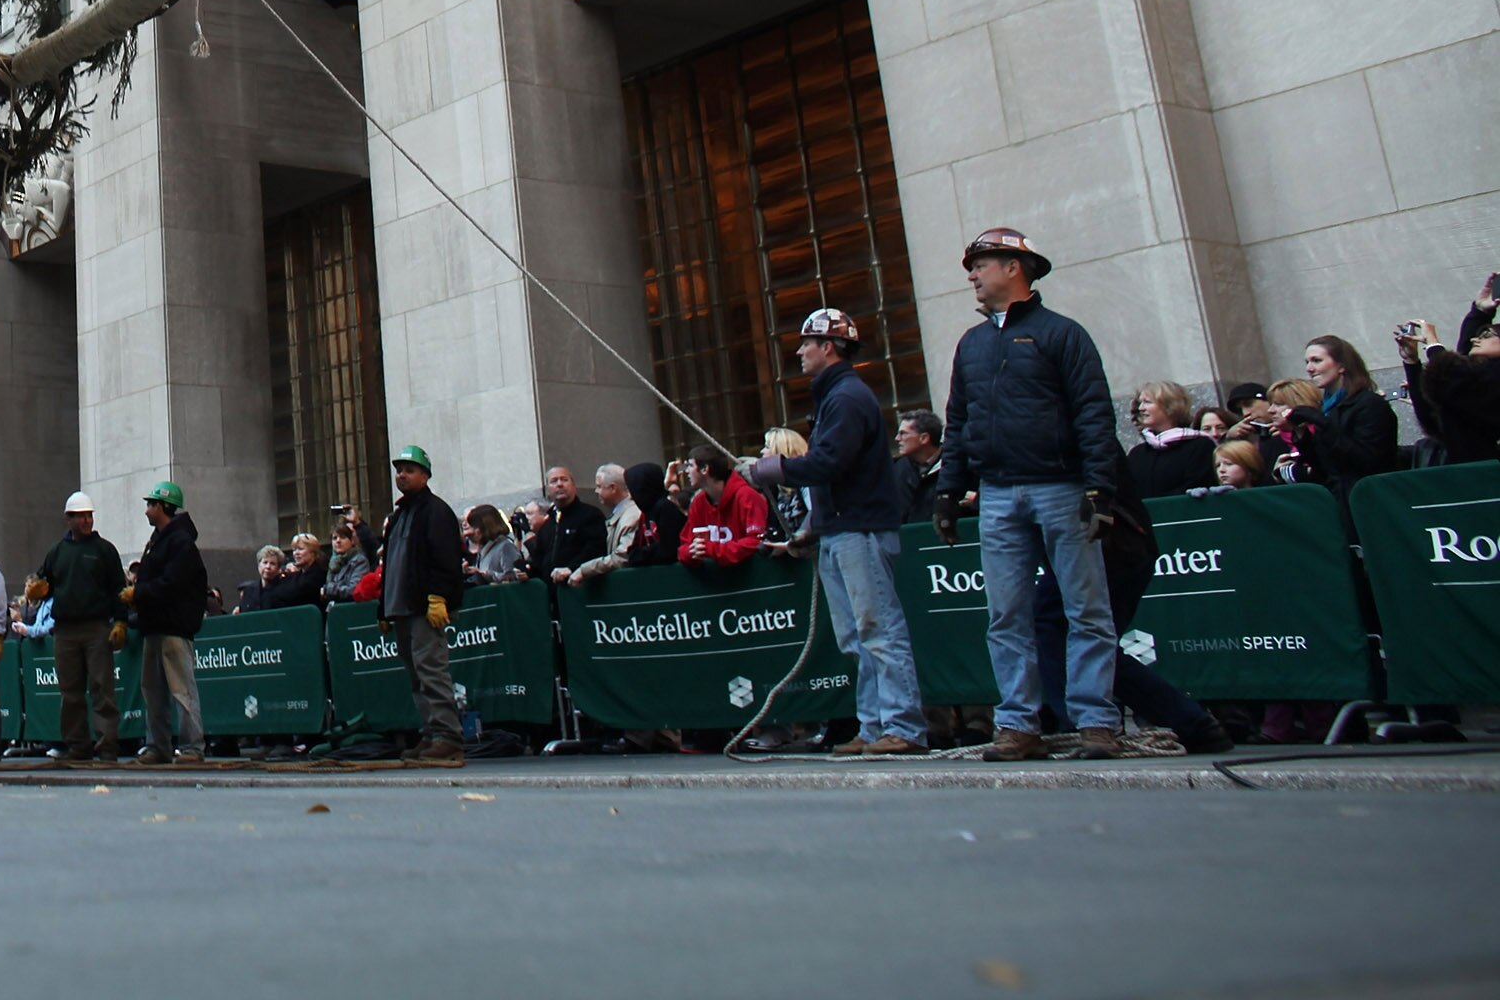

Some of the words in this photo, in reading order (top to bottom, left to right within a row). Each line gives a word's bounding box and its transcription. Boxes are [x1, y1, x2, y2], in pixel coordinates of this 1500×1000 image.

[1425, 526, 1500, 562] Ro
[1154, 548, 1222, 576] nter
[445, 625, 498, 649] Center
[593, 612, 711, 645] Rockefeller
[719, 609, 796, 637] Center
[1169, 639, 1240, 652] TISHMAN
[1242, 636, 1307, 650] SPEYER
[193, 648, 238, 670] kefeller
[241, 645, 282, 666] Center
[809, 675, 850, 690] SPEYER
